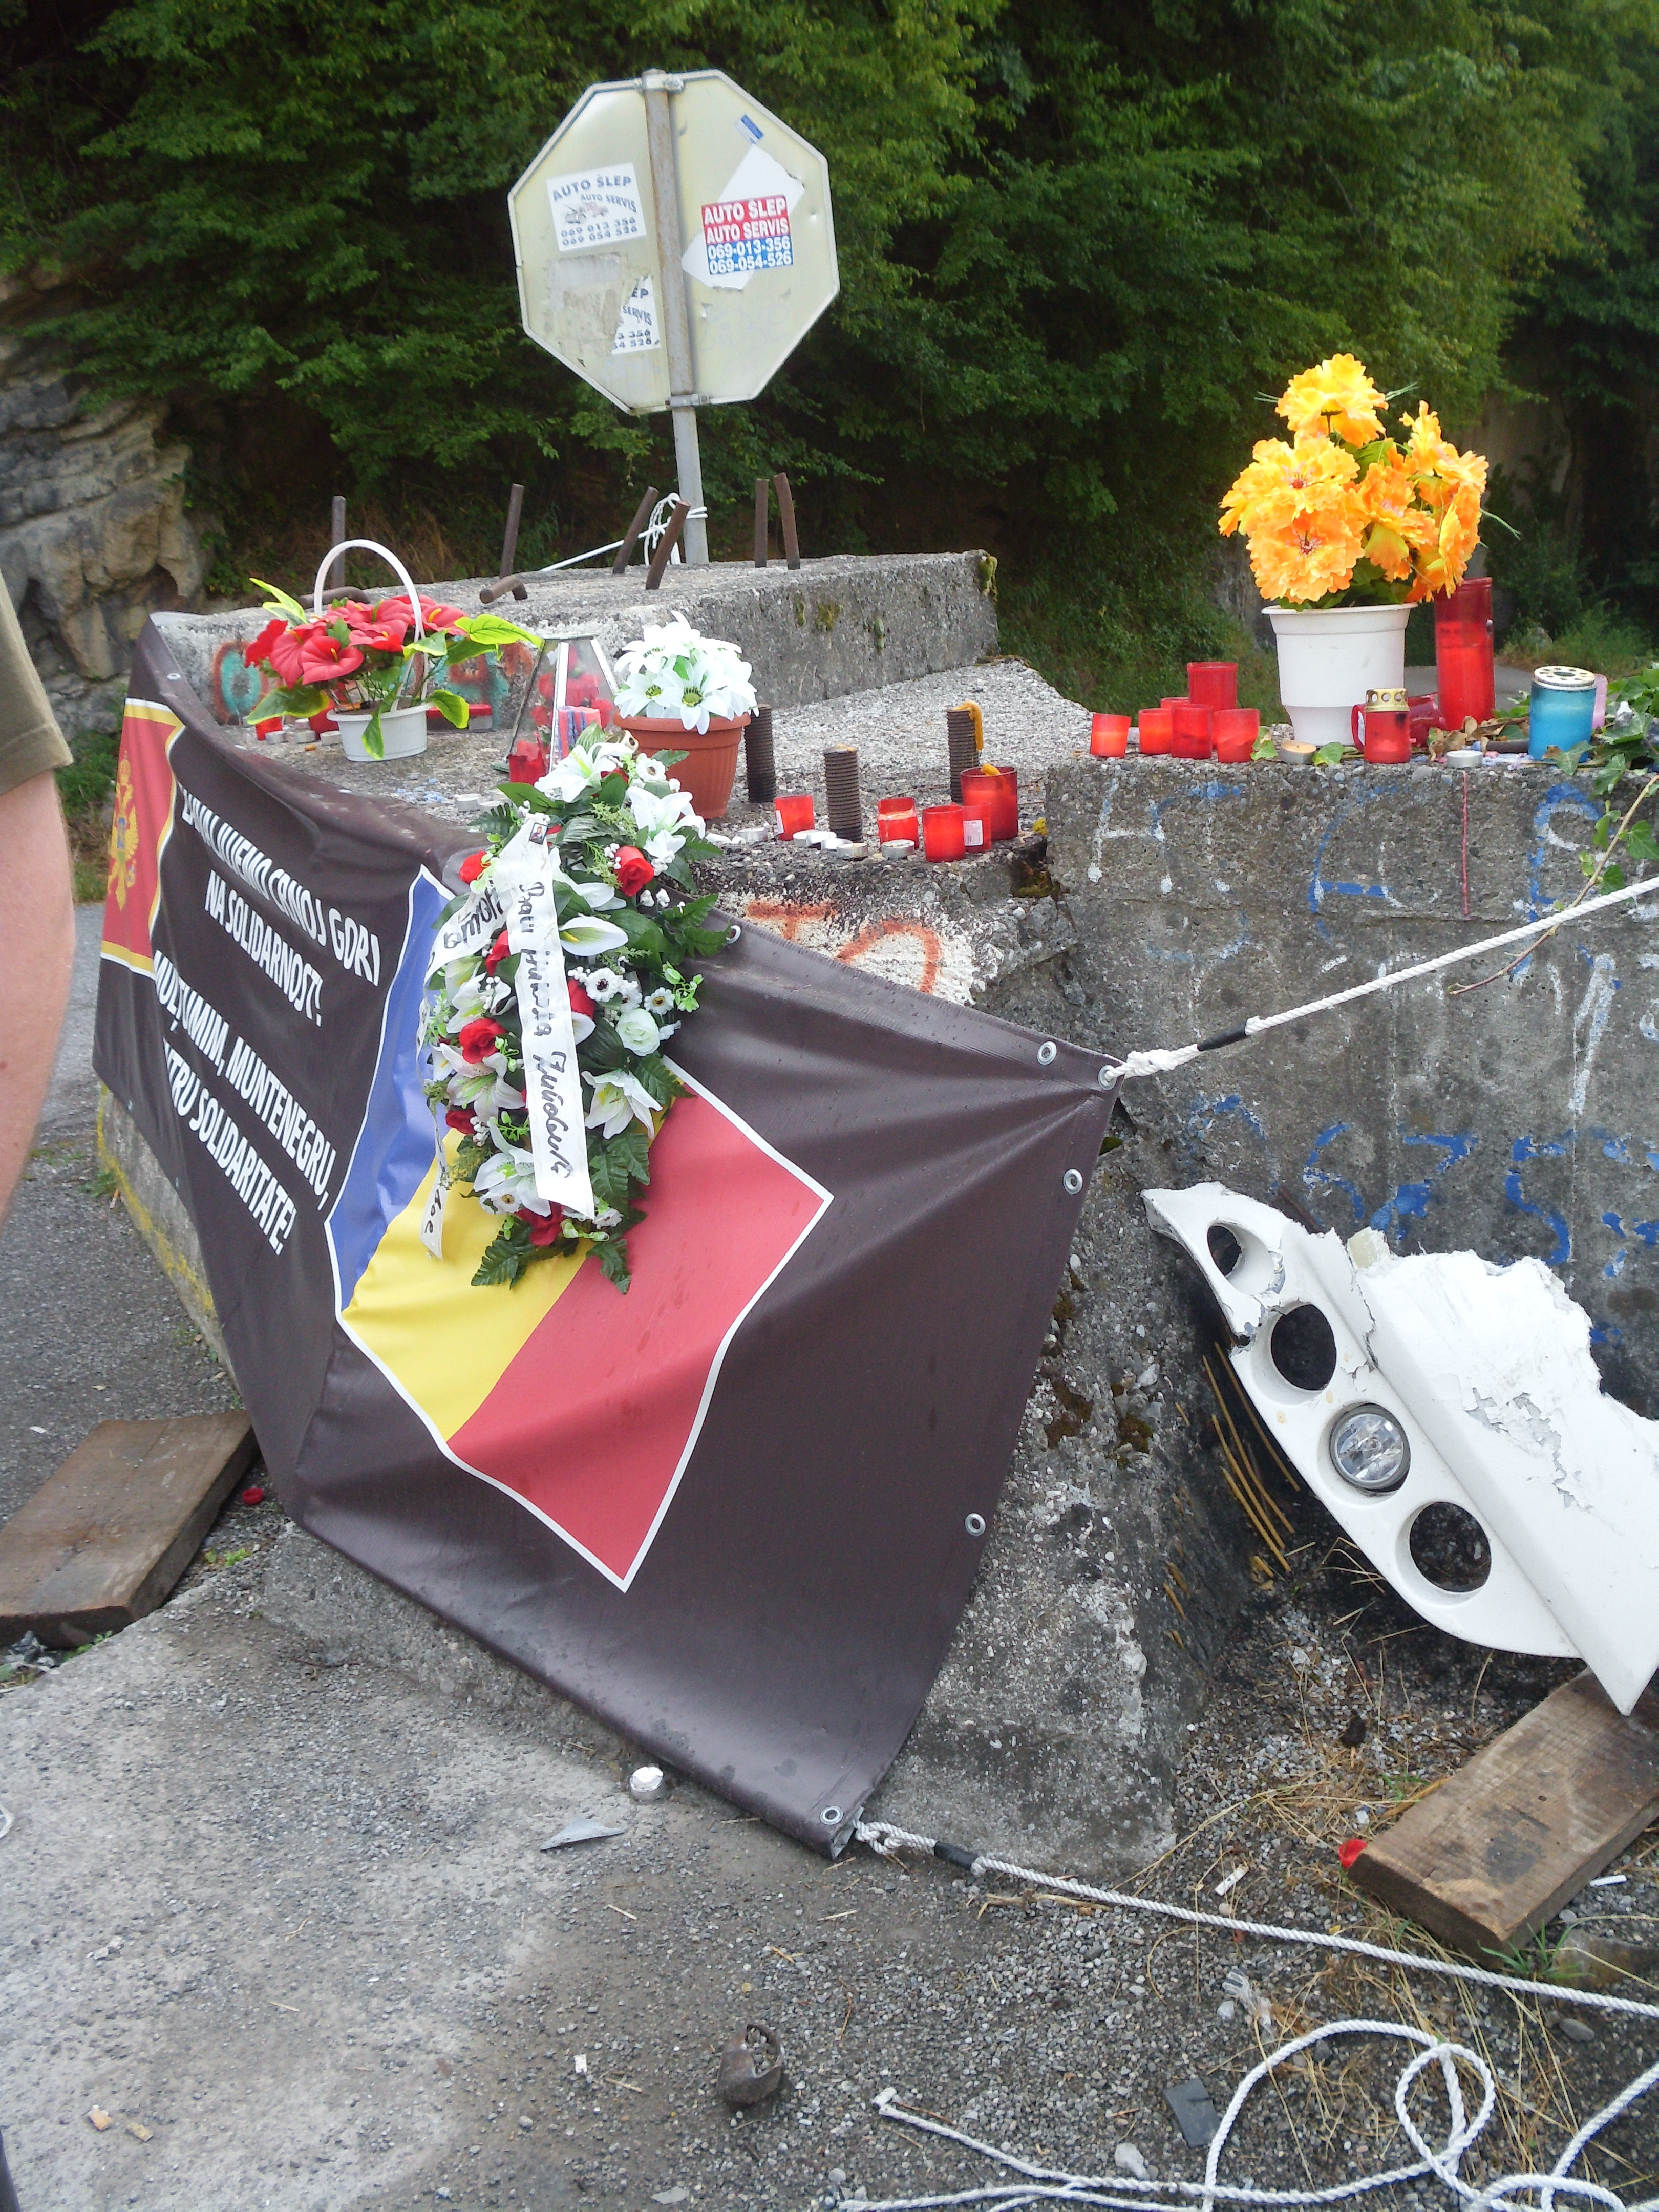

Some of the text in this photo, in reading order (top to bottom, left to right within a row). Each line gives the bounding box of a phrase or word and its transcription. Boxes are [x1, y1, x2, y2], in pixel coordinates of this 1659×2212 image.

[552, 179, 591, 202] AUTO
[606, 195, 637, 213] SERVIS
[704, 203, 745, 225] AUTO
[588, 222, 609, 232] 013
[707, 217, 789, 244] AUTO SERVIS
[708, 235, 791, 260] 069-013-356
[709, 251, 792, 274] 069-054-526
[631, 287, 649, 299] EP
[623, 306, 652, 326] SERVIS
[268, 868, 327, 947] CRNOJ
[329, 907, 381, 987] GORI
[205, 869, 324, 1027] NA SOLIDARNOST!
[225, 1035, 337, 1211] MUNTENEGRU,
[189, 1087, 297, 1256] SOLIDARITATE!
